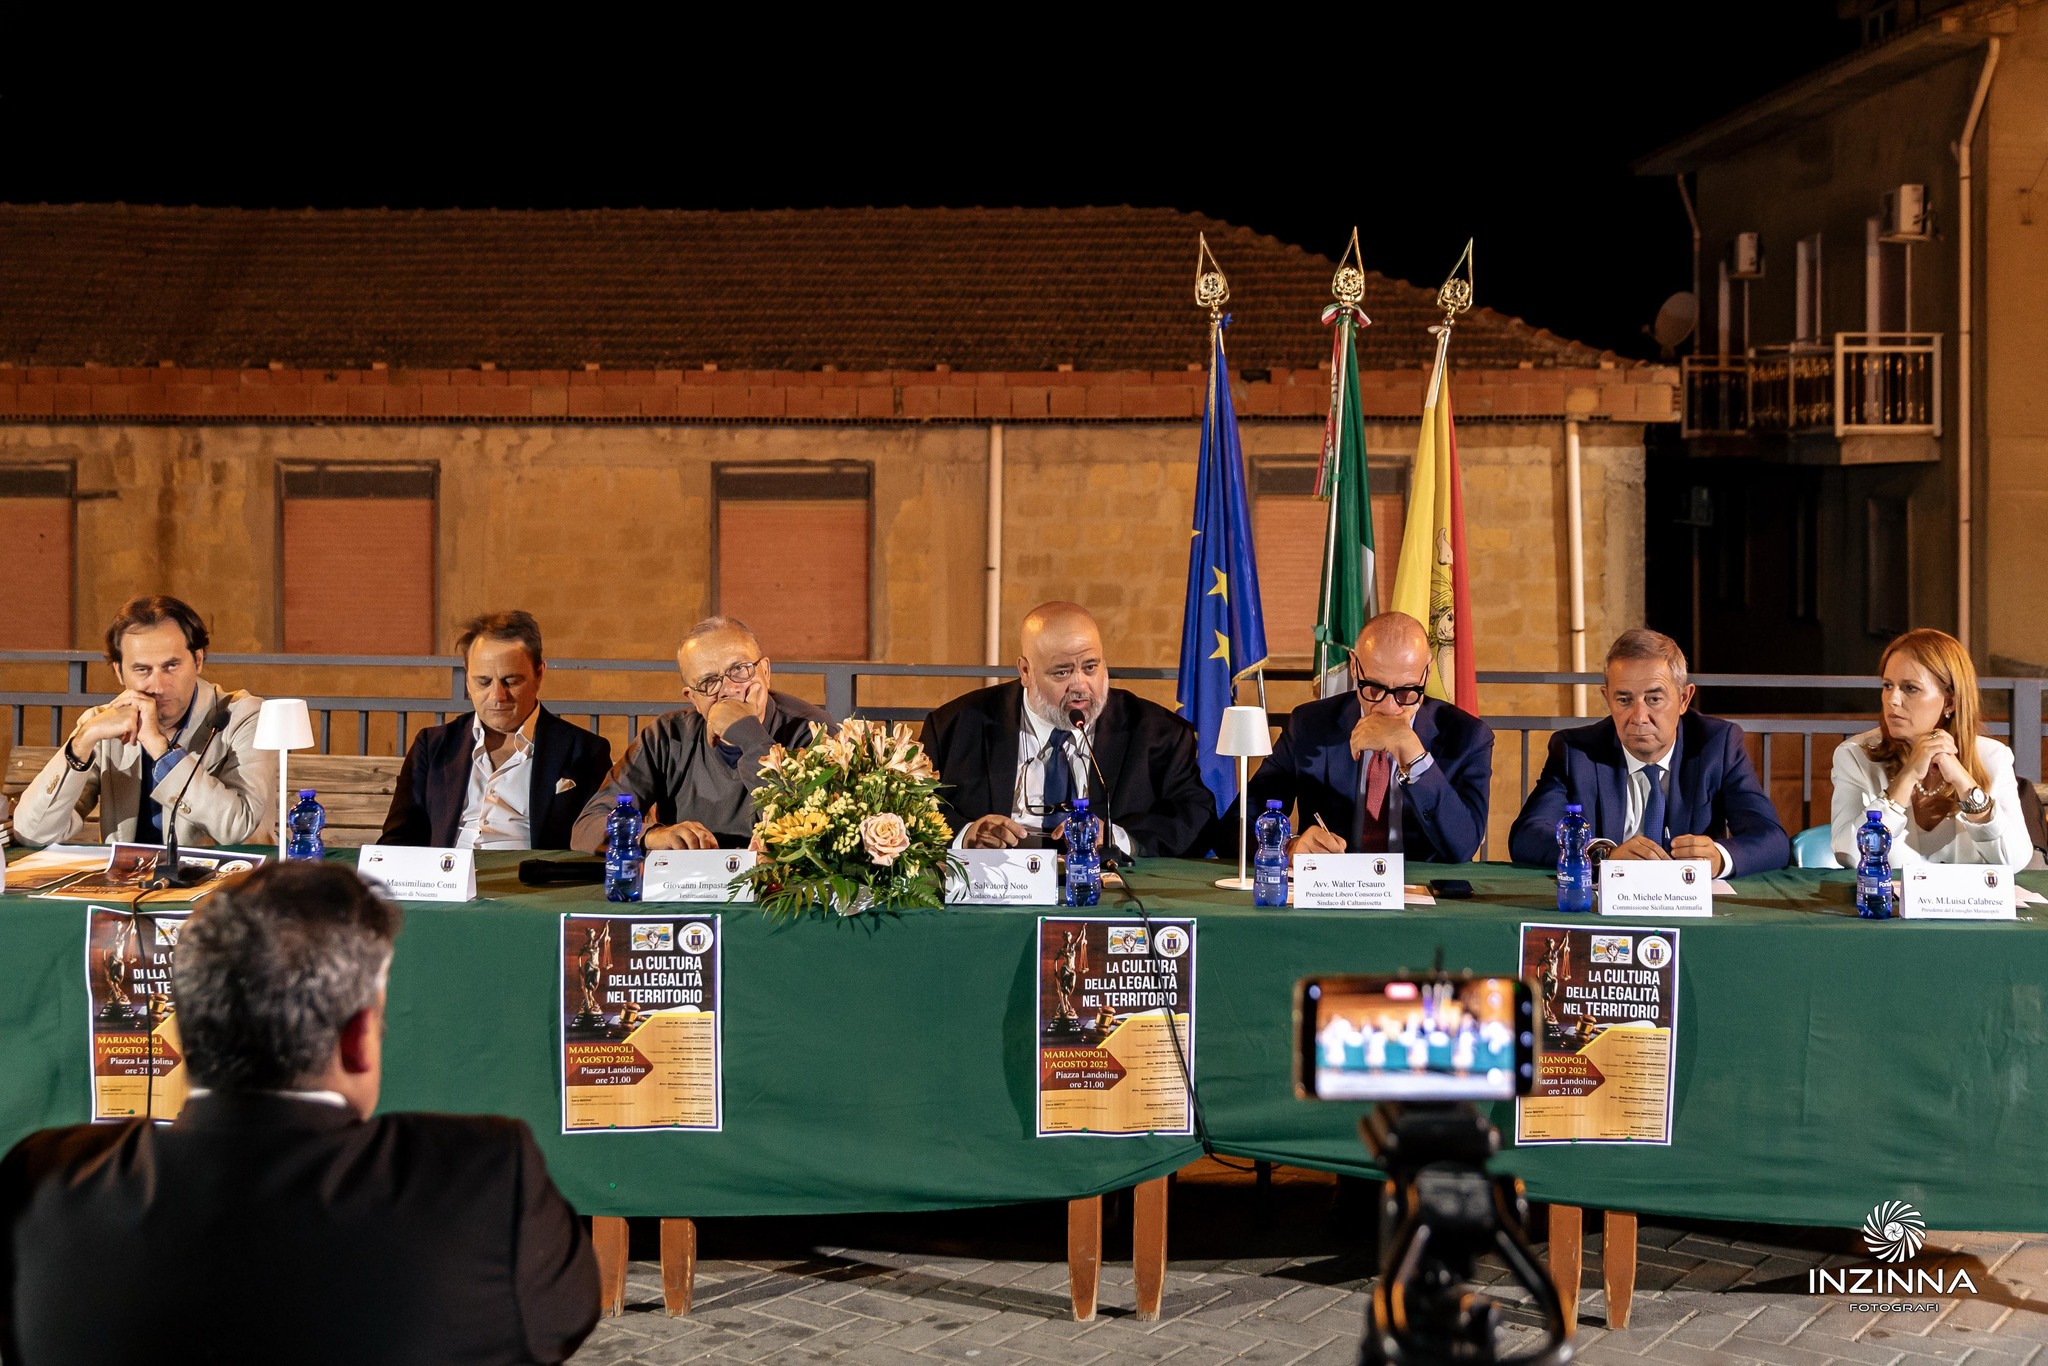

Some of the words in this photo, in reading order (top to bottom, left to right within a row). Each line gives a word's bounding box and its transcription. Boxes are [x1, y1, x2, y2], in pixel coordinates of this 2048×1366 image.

[387, 879, 436, 888] Massimiliano
[437, 880, 457, 889] Conti
[663, 881, 697, 890] Giovanni
[699, 881, 728, 891] Impasta
[974, 881, 1008, 890] Salvatore
[1010, 882, 1029, 890] Noto
[1313, 880, 1329, 888] Avv.
[1331, 880, 1355, 888] Walter
[1358, 880, 1385, 888] Tesauro
[998, 893, 1033, 901] Marianopoli
[1617, 893, 1631, 901] On.
[1633, 892, 1663, 901] Michele
[1664, 893, 1697, 901] Mancuso
[1918, 896, 1934, 905] Avv.
[1967, 897, 2004, 906] Calabrese
[153, 952, 167, 965] LA
[630, 958, 643, 970] LA
[646, 956, 703, 970] CULTURA
[1107, 961, 1119, 973] LA
[609, 974, 643, 987] DELLA
[644, 971, 703, 987] LEGALITÀ
[1588, 970, 1601, 983] LA
[1604, 969, 1661, 985] CULTURA
[1085, 978, 1116, 990] DELLA
[607, 991, 626, 1003] NEL
[629, 989, 703, 1003] TERRITORIO
[1566, 986, 1598, 999] DELLA
[1601, 985, 1659, 1003] LEGALITÀ
[1082, 995, 1102, 1007] NEL
[1563, 1002, 1583, 1015] NEL
[1586, 1001, 1659, 1019] TERRITORIO
[104, 1046, 143, 1054] AGOSTO
[569, 1046, 634, 1054] MARIANOPOLI
[575, 1056, 614, 1064] AGOSTO
[616, 1055, 634, 1063] 2025
[1044, 1051, 1108, 1059] MARIANOPOLI
[110, 1057, 135, 1065] Piazza
[1090, 1060, 1108, 1068] 2025
[1538, 1056, 1587, 1065] RIANOPOLI
[607, 1066, 645, 1074] Landolina
[1055, 1071, 1079, 1079] Piazza
[1081, 1071, 1119, 1079] Landolina
[610, 1076, 631, 1084] 21.00
[1560, 1077, 1597, 1085] Landolina
